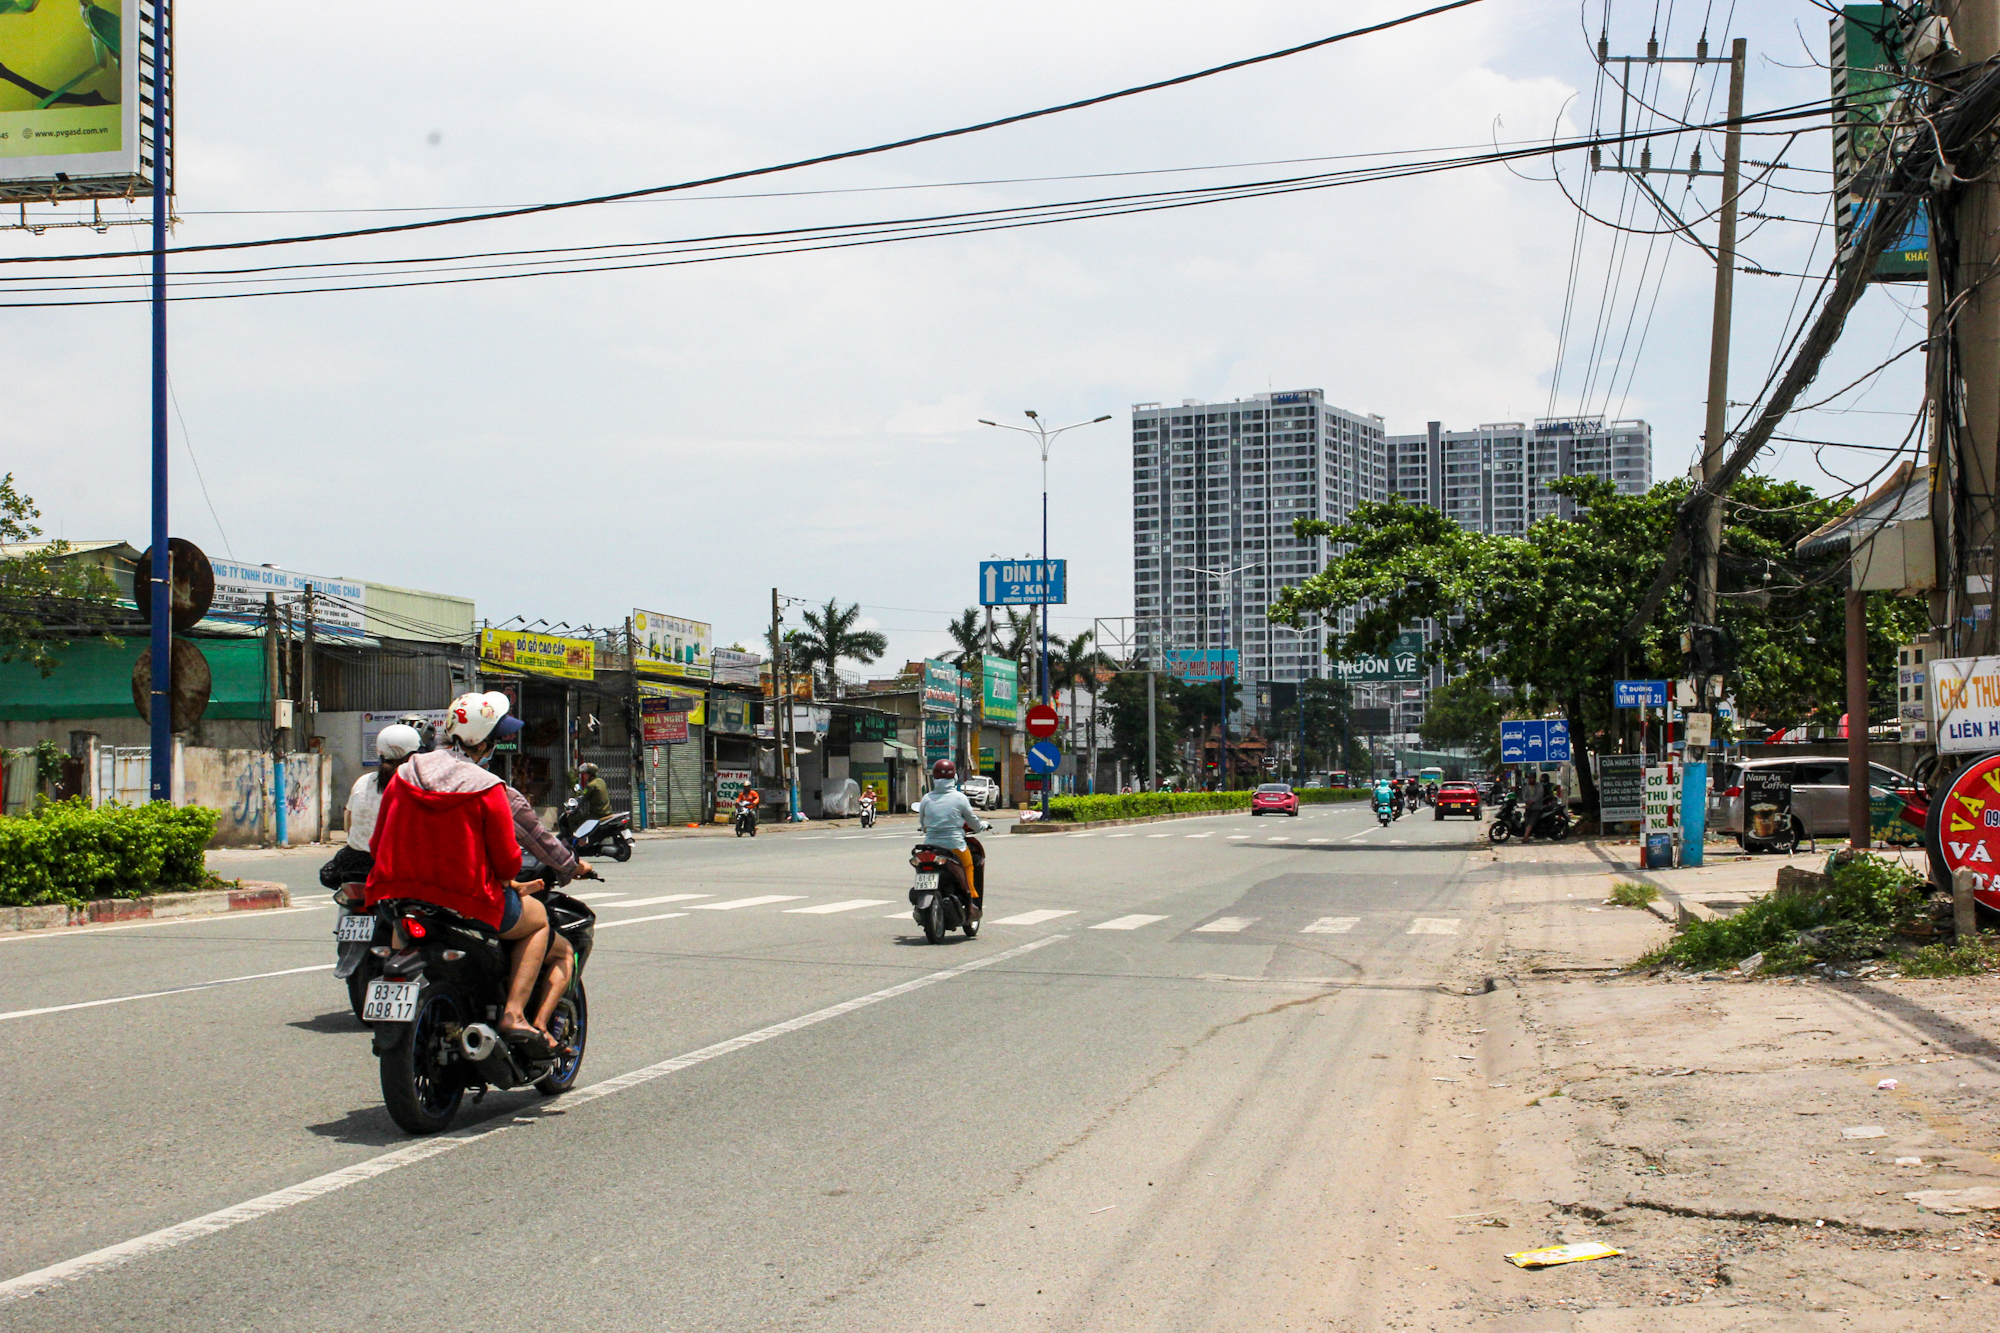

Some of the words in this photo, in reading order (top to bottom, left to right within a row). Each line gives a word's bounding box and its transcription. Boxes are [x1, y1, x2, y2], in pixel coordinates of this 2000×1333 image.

[34, 127, 109, 138] www.pvgasd.com.vn
[211, 561, 227, 577] ÔNG
[240, 569, 261, 582] TNHH
[323, 582, 342, 596] LONG
[1002, 561, 1031, 583] DÌN
[1010, 584, 1020, 595] 2
[1024, 584, 1050, 595] KM
[538, 641, 552, 655] CAO
[1653, 693, 1663, 704] 21
[1949, 719, 1983, 739] LIÊN
[1989, 720, 2000, 737] H
[926, 738, 949, 749] CNC
[1647, 774, 1663, 787] CƠ
[1745, 773, 1767, 782] Nam
[1768, 773, 1781, 781] An
[1761, 780, 1790, 791] Coffee
[1646, 787, 1682, 801] THUC
[1950, 790, 1986, 833] VÁ
[1948, 839, 1993, 863] VÁ
[345, 916, 370, 928] 75-H1
[338, 929, 371, 941] 331.44
[373, 984, 411, 1002] 83-Z1
[366, 1002, 413, 1021] 098.17
